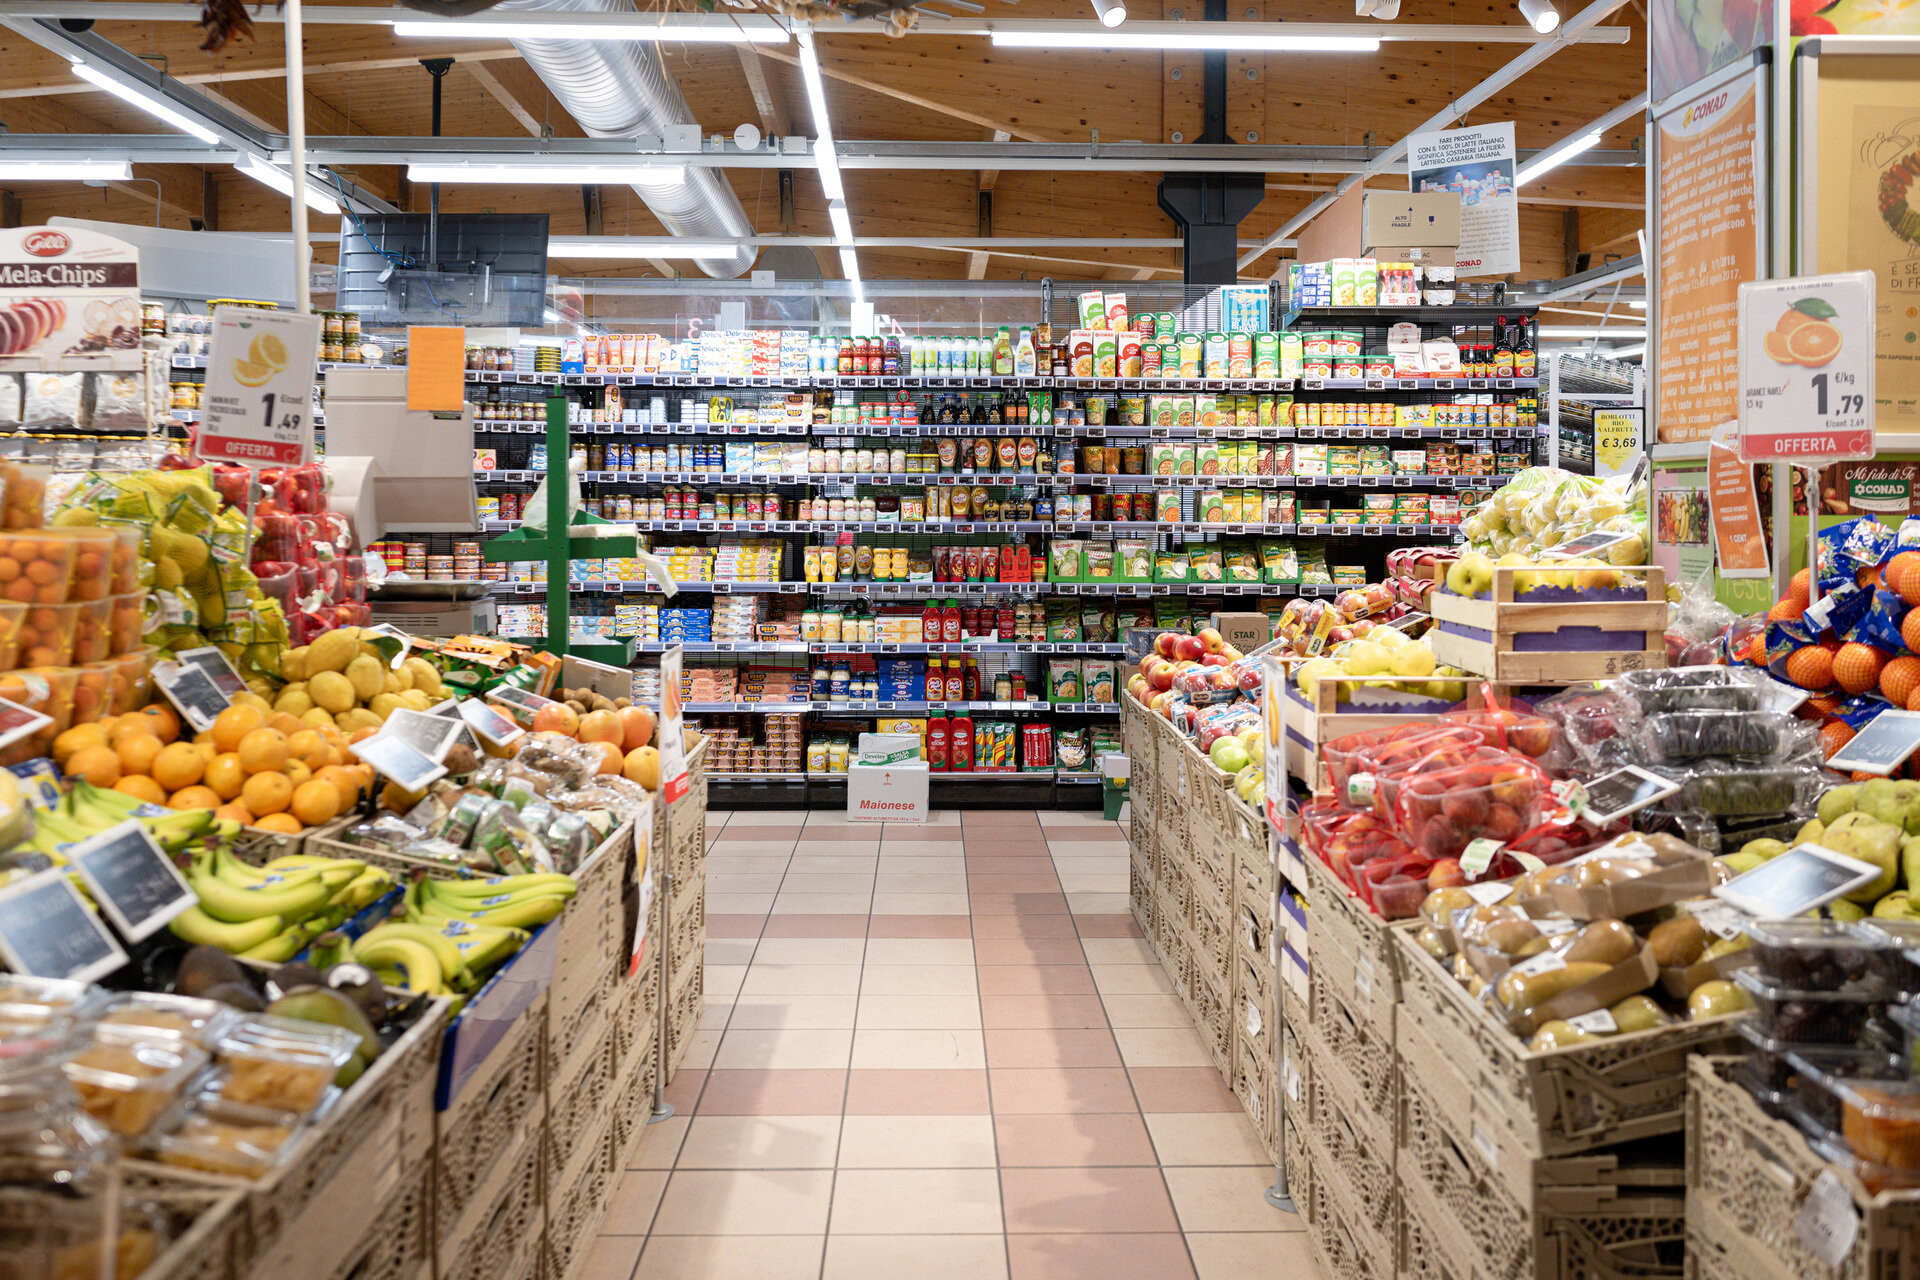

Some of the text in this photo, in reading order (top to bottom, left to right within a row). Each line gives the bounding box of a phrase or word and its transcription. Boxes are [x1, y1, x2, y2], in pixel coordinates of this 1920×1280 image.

[1693, 92, 1728, 122] CONAD
[1454, 133, 1482, 142] PRODOTTI
[1478, 137, 1505, 145] ITALIANO
[1418, 152, 1444, 160] SIGNIFICA
[1446, 148, 1477, 157] SOSTENERE
[1421, 158, 1446, 167] LATTIERO
[1447, 155, 1474, 163] CASEARIA
[1731, 169, 1746, 182] fuori
[1456, 260, 1482, 268] CONAD
[1892, 264, 1898, 276] È
[1891, 279, 1903, 289] DI
[1836, 372, 1855, 385] €/kg
[1811, 373, 1828, 415] 1
[262, 393, 276, 427] 1
[1756, 399, 1763, 409] kg
[226, 442, 276, 457] OFFERTA
[1602, 438, 1637, 449] € 3,69
[1775, 437, 1837, 453] OFFERTA
[1845, 466, 1918, 484] Mi fido di Te
[1866, 485, 1905, 495] CONAD
[1734, 534, 1747, 543] CENT
[1234, 631, 1255, 639] STAR
[860, 800, 915, 811] Maionese
